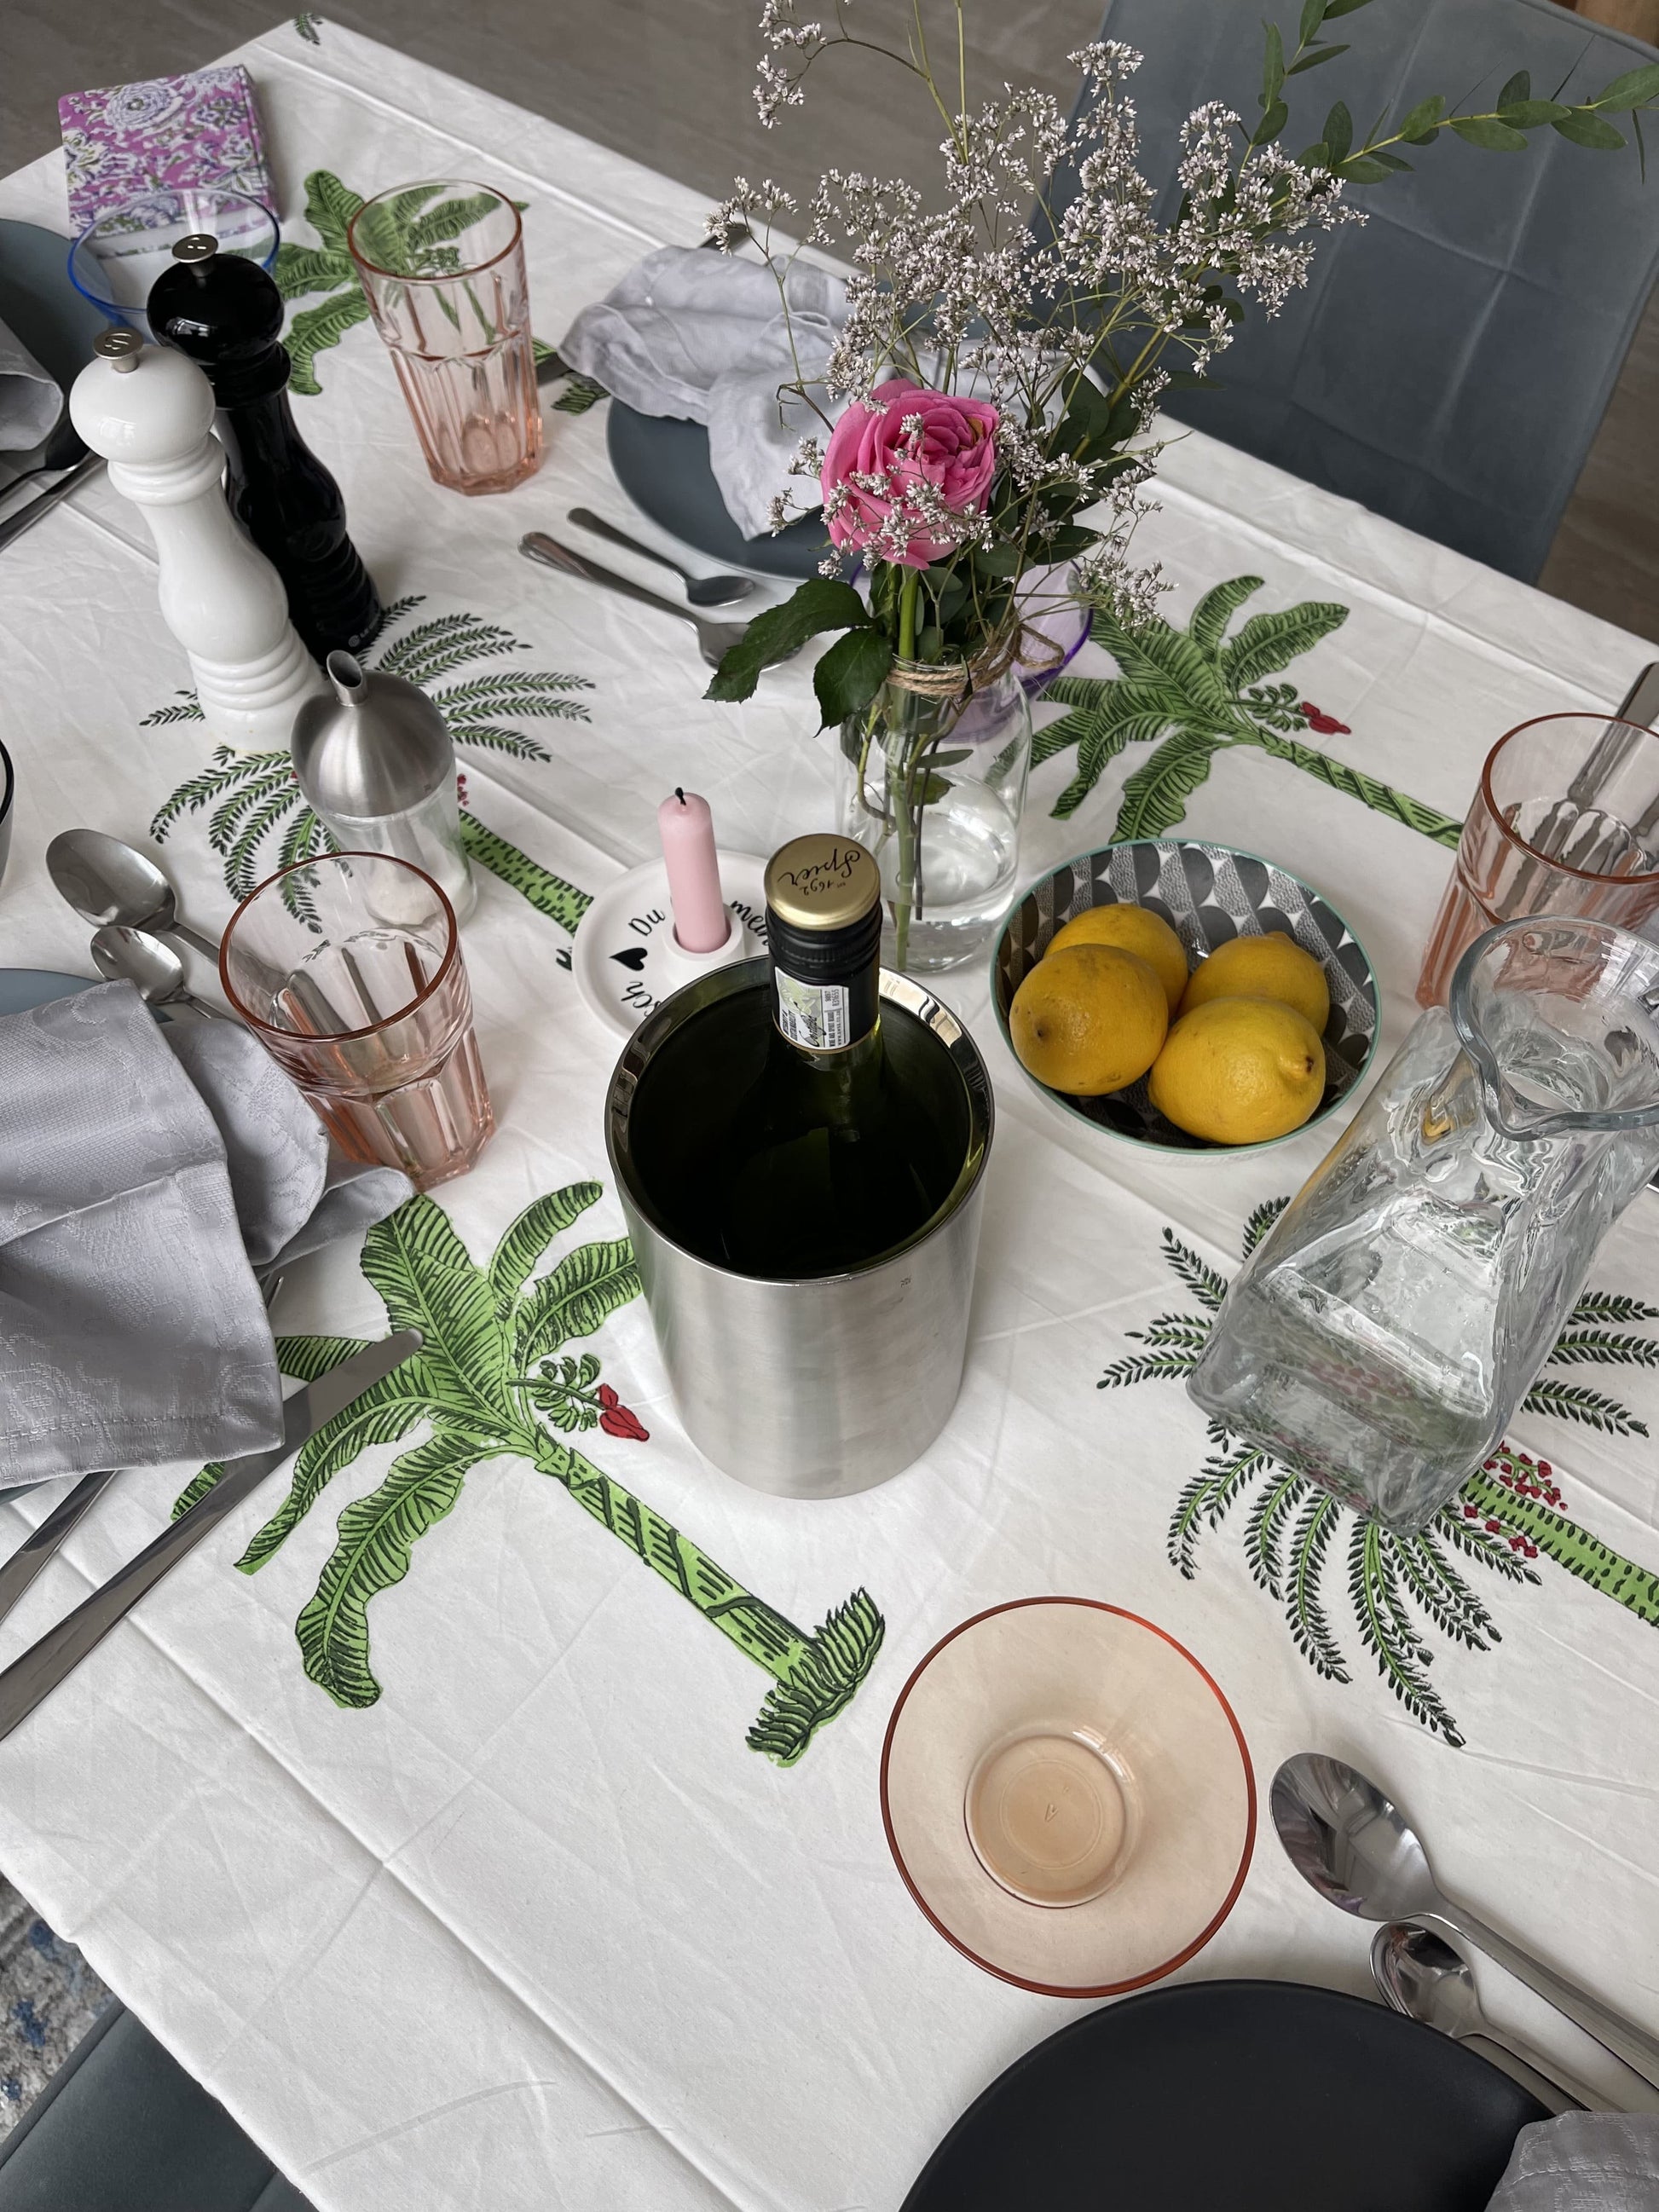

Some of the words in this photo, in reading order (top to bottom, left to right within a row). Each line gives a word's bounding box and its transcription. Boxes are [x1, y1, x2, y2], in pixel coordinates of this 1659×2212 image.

[777, 848, 860, 887] Spier
[799, 878, 834, 896] 1692
[628, 909, 665, 936] Du
